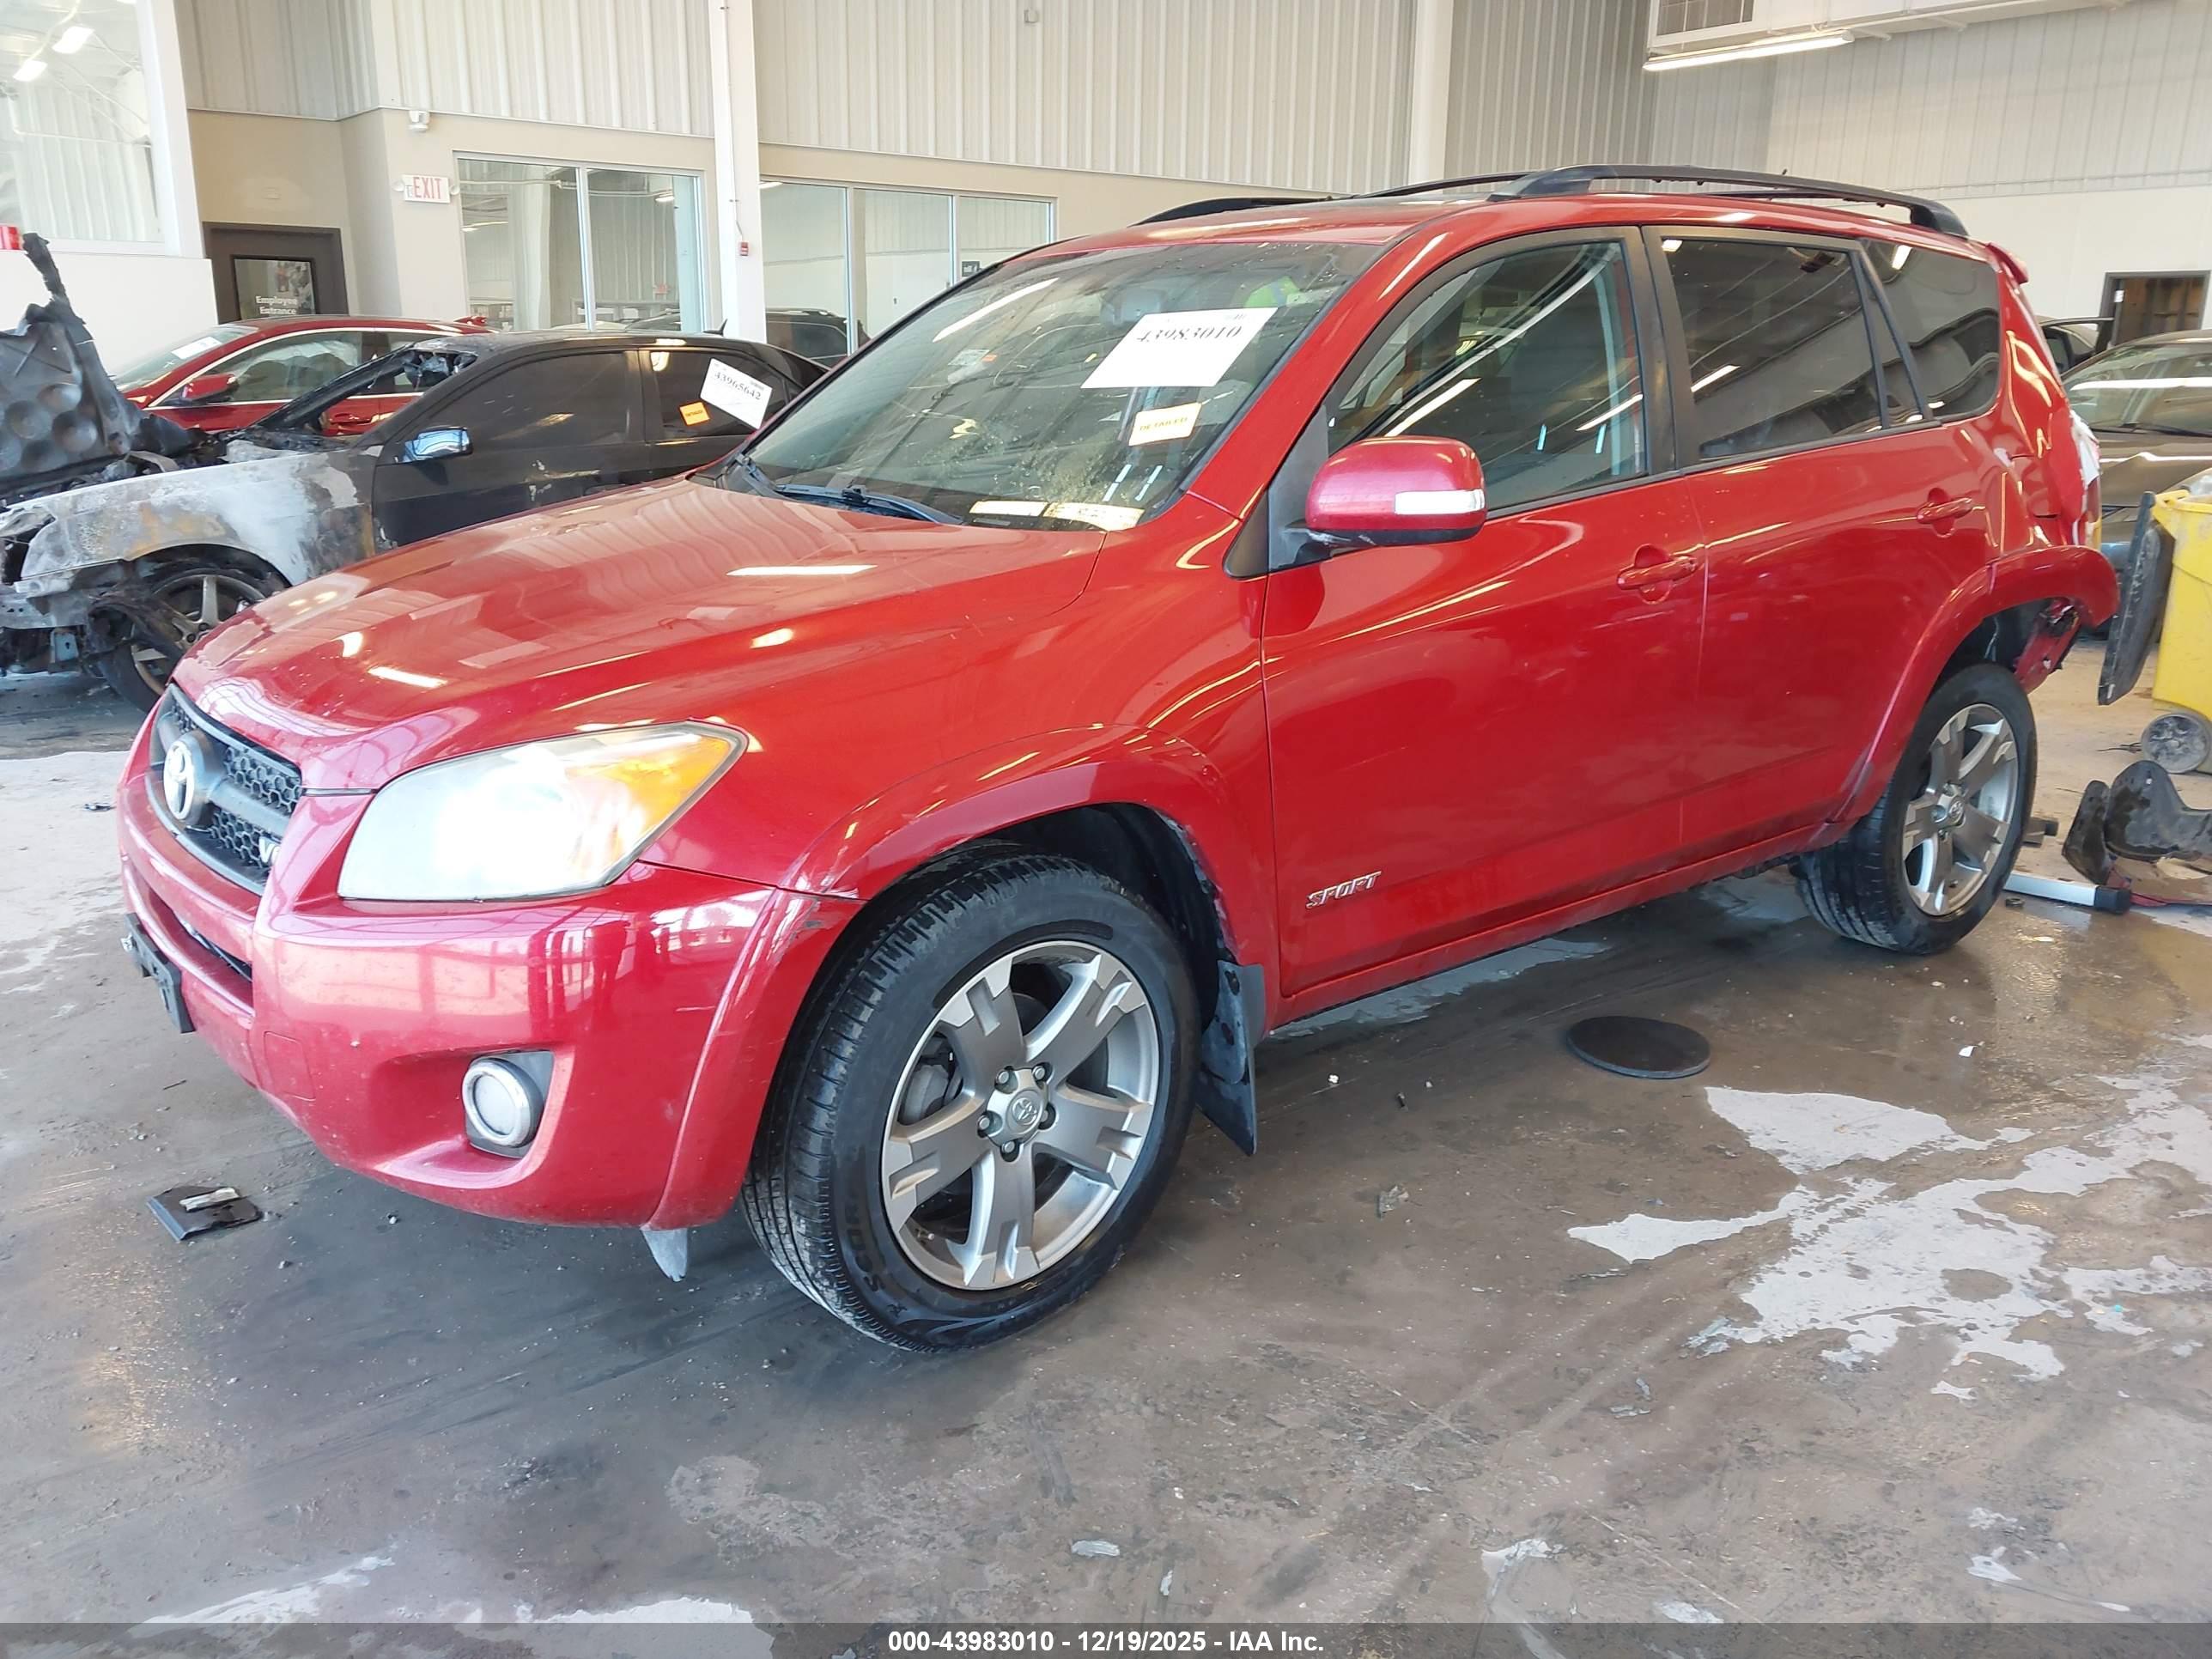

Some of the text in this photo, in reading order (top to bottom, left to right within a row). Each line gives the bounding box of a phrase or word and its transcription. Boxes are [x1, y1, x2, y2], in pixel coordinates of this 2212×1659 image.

[413, 176, 441, 199] EXIT
[255, 295, 297, 306] Employee
[714, 371, 762, 400] 43965642
[1305, 871, 1382, 909] SPORT
